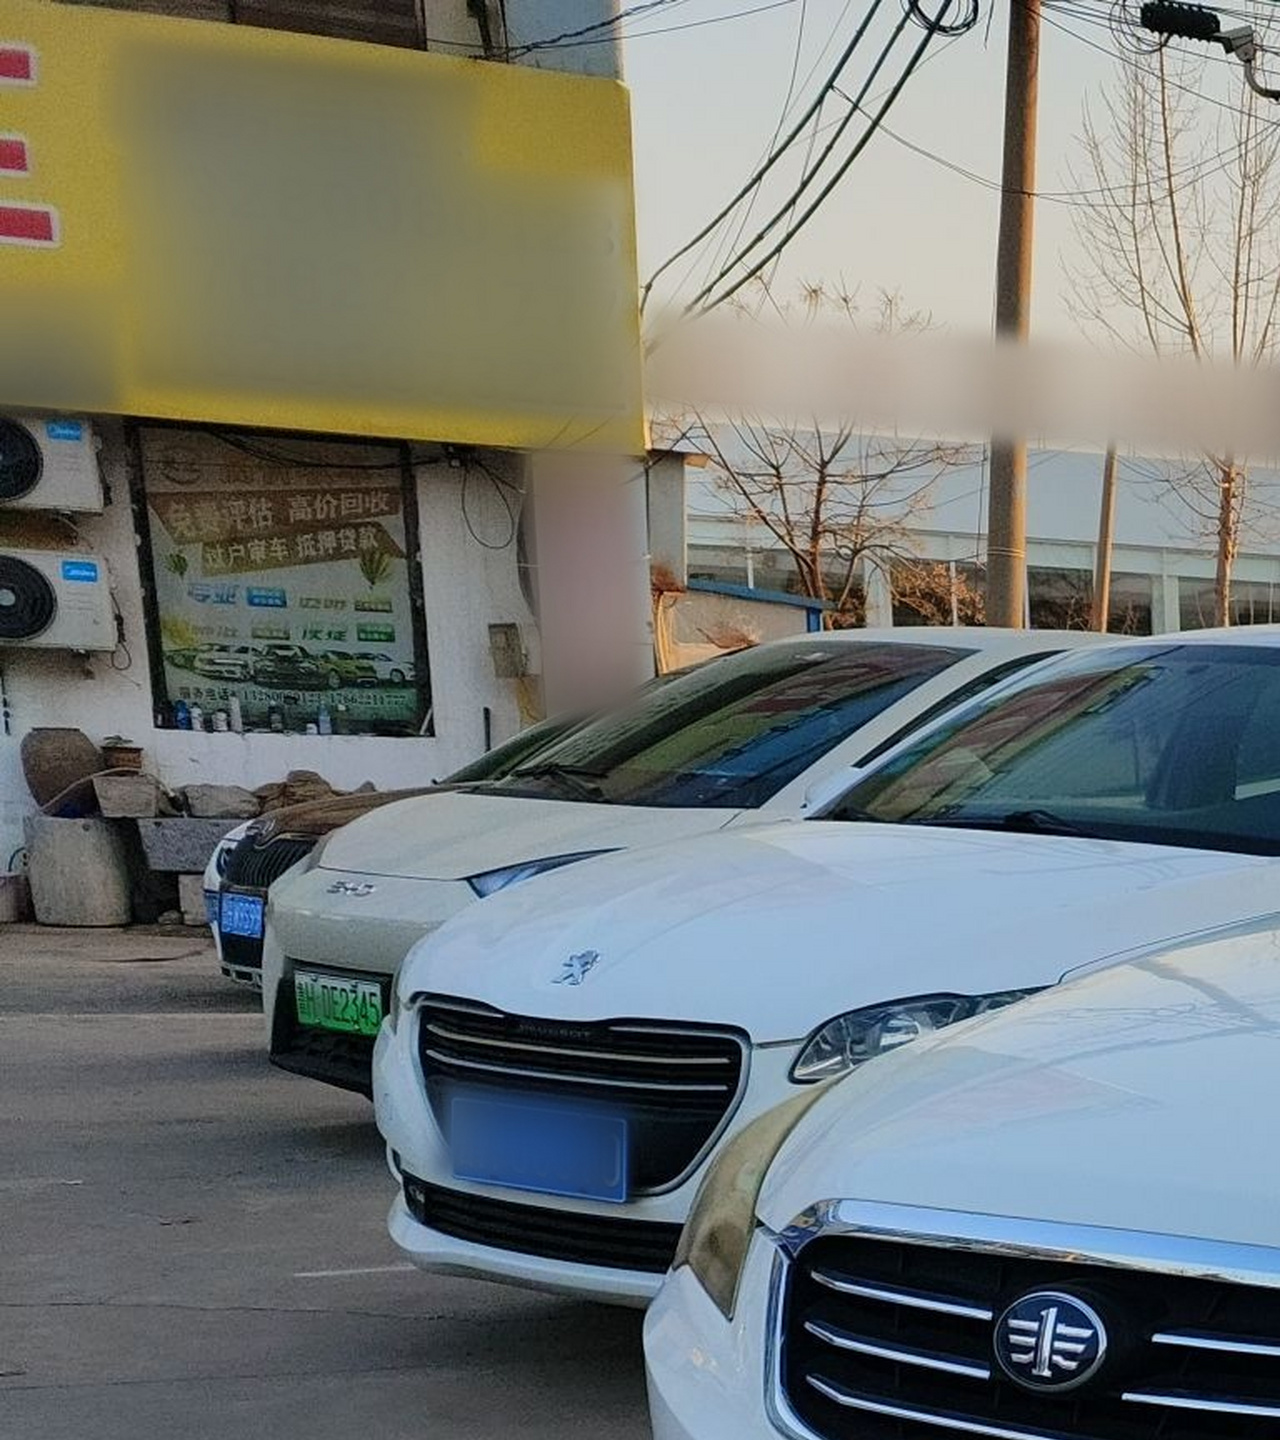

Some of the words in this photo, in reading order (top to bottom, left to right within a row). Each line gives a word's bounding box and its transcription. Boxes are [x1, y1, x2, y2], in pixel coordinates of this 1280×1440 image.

[287, 490, 391, 523] 高价回收
[296, 525, 379, 559] 抵押贷款
